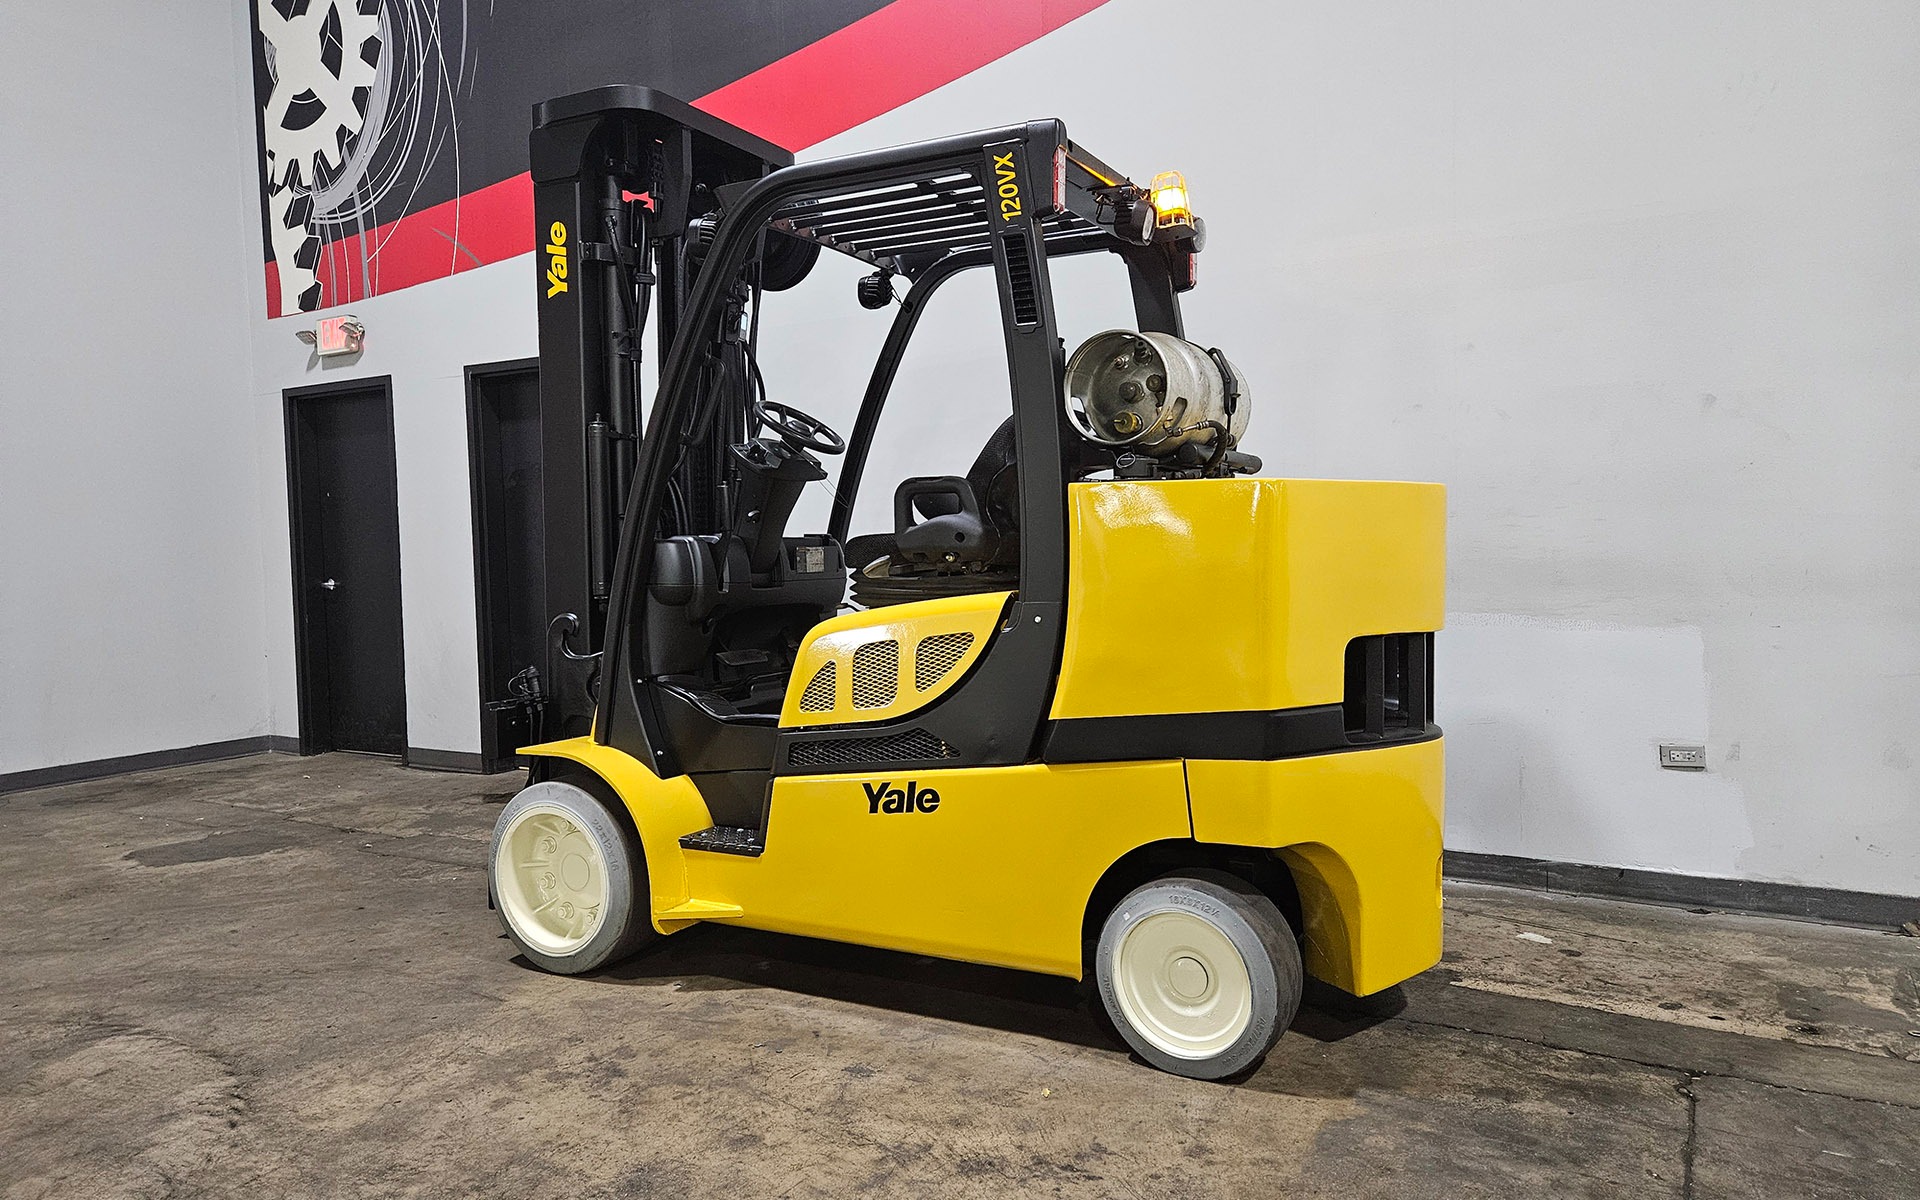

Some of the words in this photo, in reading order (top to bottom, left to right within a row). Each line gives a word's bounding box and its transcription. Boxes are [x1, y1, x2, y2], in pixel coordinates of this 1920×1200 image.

[993, 151, 1022, 222] 120VX
[546, 221, 568, 299] Yale
[862, 781, 941, 814] Yale
